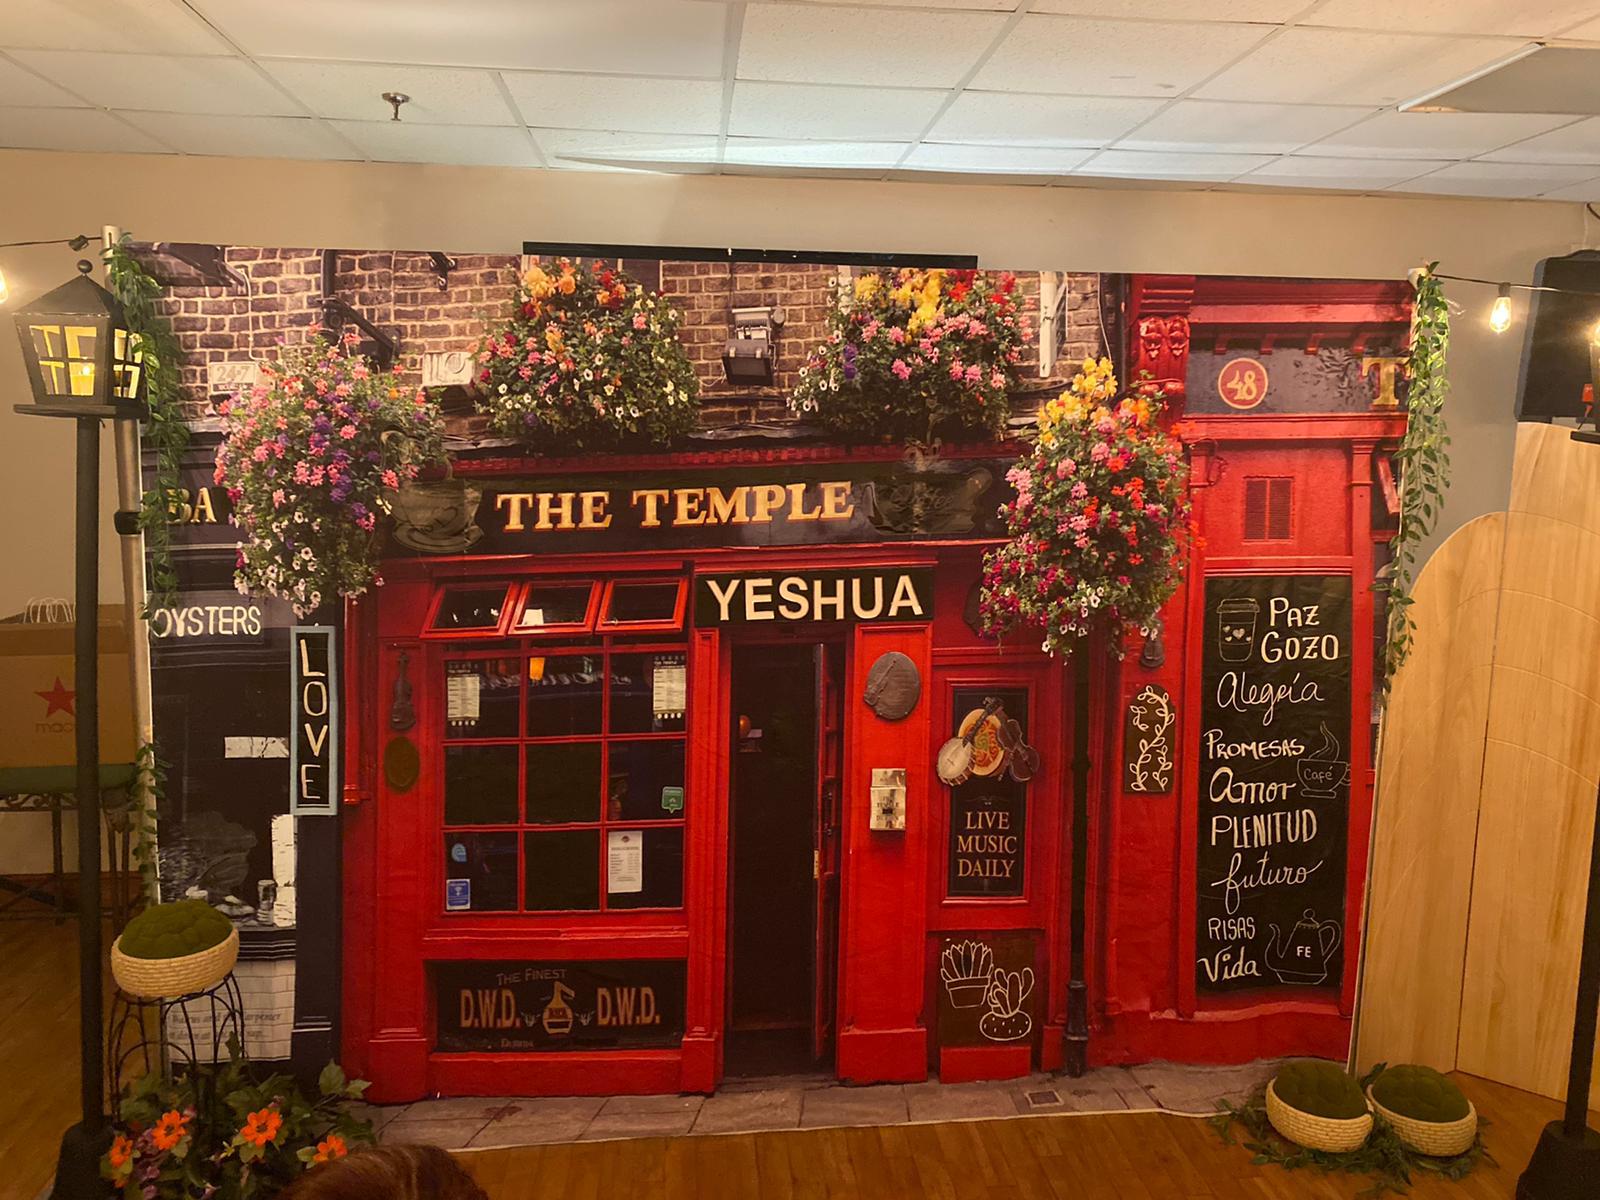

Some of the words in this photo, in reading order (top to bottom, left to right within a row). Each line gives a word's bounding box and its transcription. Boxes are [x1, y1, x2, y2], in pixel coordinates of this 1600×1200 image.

[496, 489, 613, 531] THE
[632, 480, 856, 527] TEMPLE
[707, 574, 924, 621] YESHUA
[151, 605, 261, 638] OYSTERS
[1261, 631, 1339, 663] GOZO
[1217, 671, 1325, 726] Alegría
[299, 638, 329, 799] LOVE
[1209, 766, 1297, 804] Amor
[1304, 766, 1334, 783] Café
[965, 811, 1010, 829] LIVE
[1211, 809, 1318, 849] PLENITUD
[956, 835, 1017, 854] MUSIC
[957, 859, 1016, 878] DAILY
[1211, 851, 1324, 915] futuro
[1208, 916, 1256, 940] RISAS
[1197, 945, 1262, 983] Vida
[1296, 945, 1312, 958] FE
[496, 973, 521, 986] THE
[525, 968, 567, 981] FINEST
[460, 988, 521, 1029] D.W.D.
[597, 986, 661, 1026] D.W.D.
